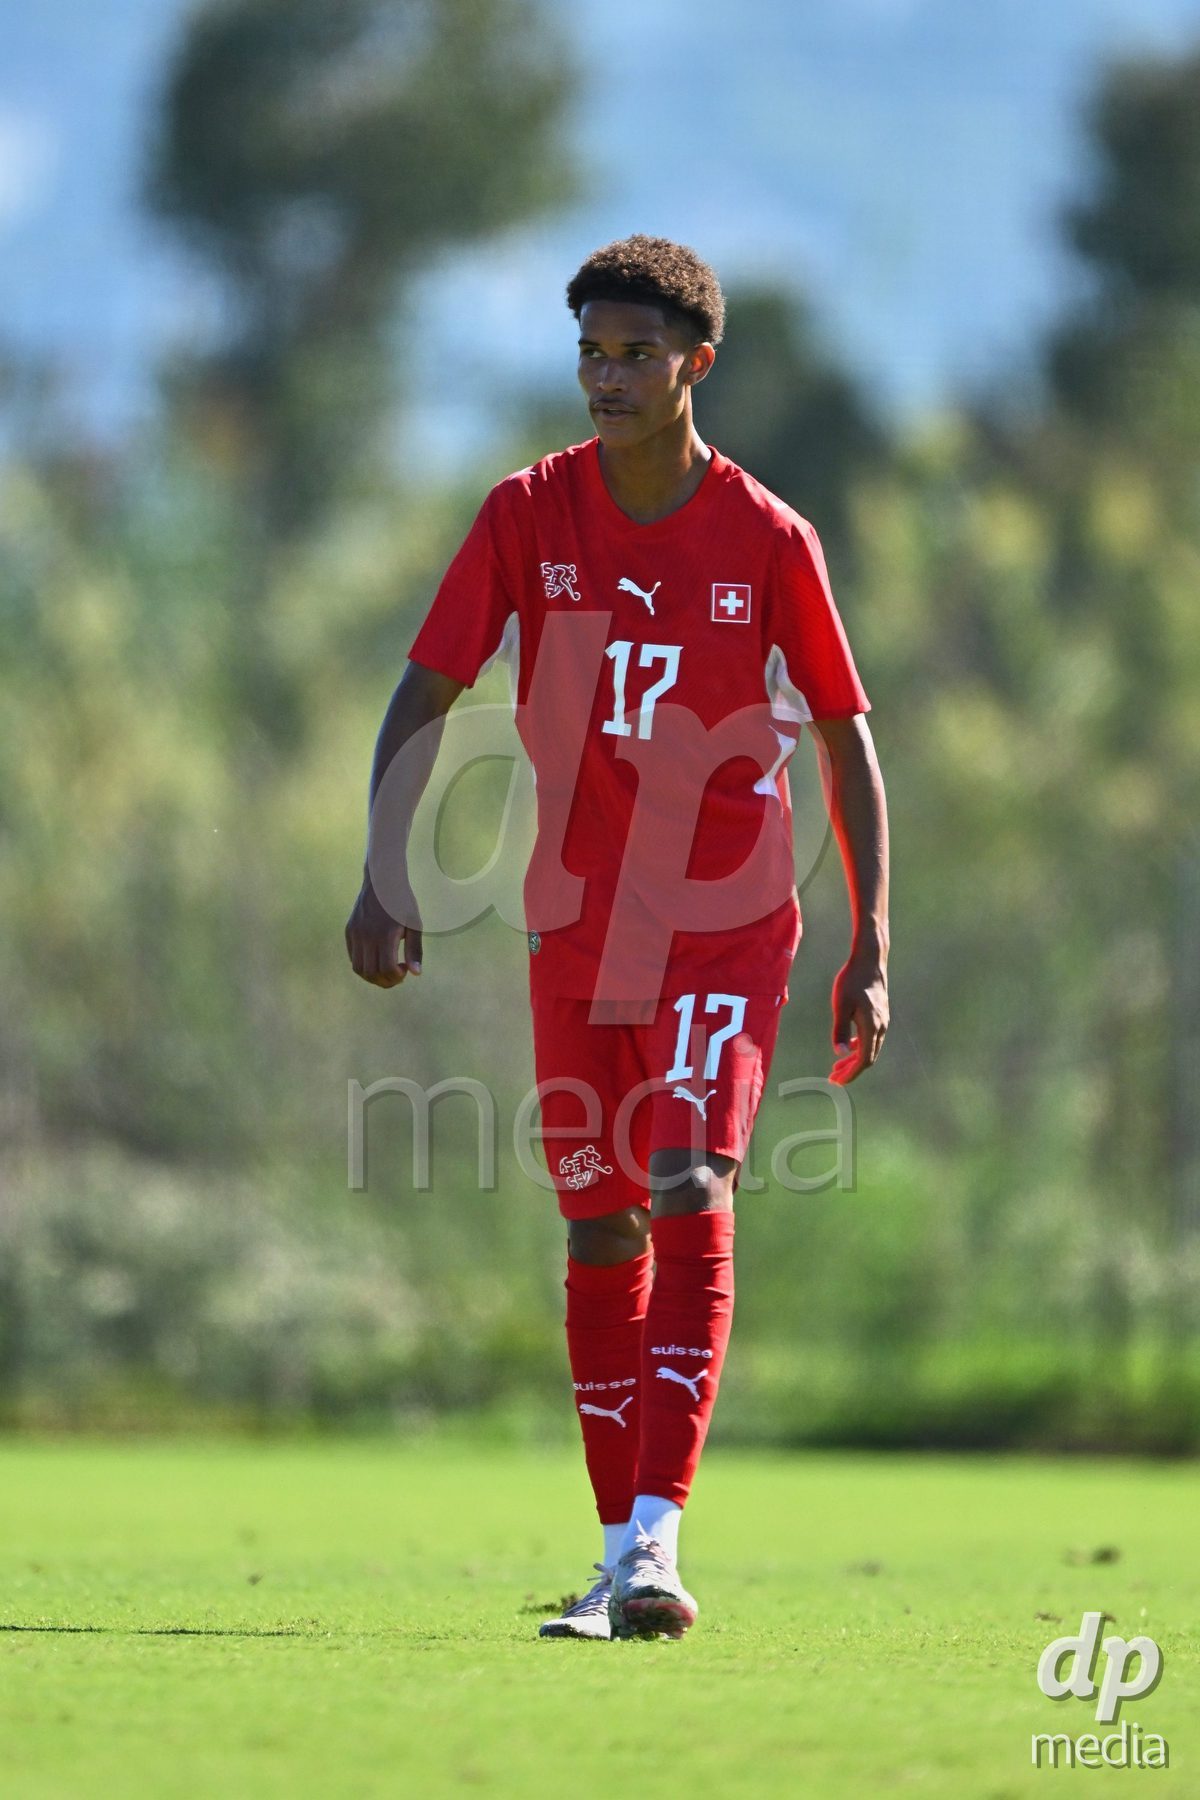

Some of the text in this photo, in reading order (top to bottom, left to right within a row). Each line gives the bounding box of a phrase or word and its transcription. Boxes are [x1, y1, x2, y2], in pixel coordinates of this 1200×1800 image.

[601, 640, 684, 740] 17
[665, 993, 749, 1083] 17
[650, 1344, 713, 1359] suisse
[572, 1377, 637, 1391] suisse
